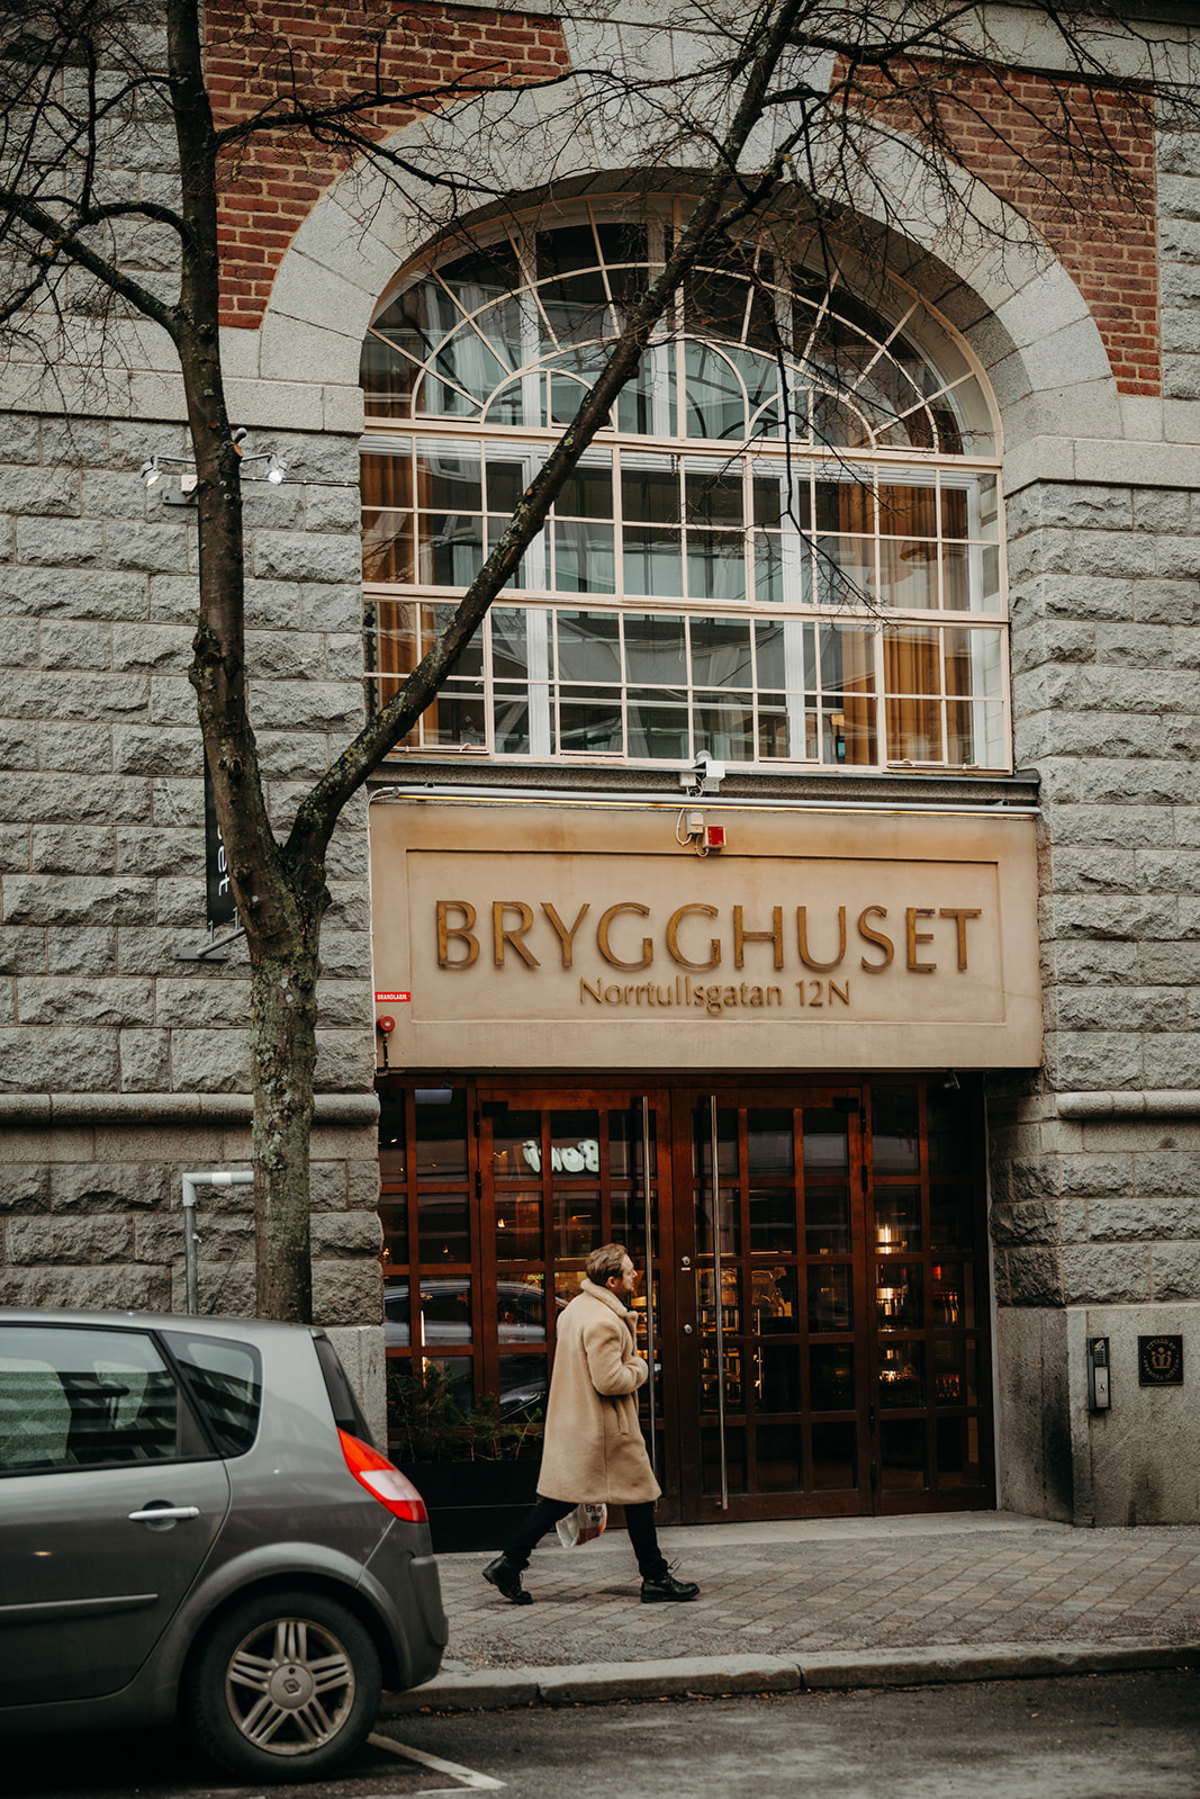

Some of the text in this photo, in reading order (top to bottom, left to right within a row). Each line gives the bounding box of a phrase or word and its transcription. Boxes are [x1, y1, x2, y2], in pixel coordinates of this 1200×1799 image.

[436, 900, 982, 974] BRYGGHUSET
[579, 975, 850, 1015] Norrtullsgatan 12N
